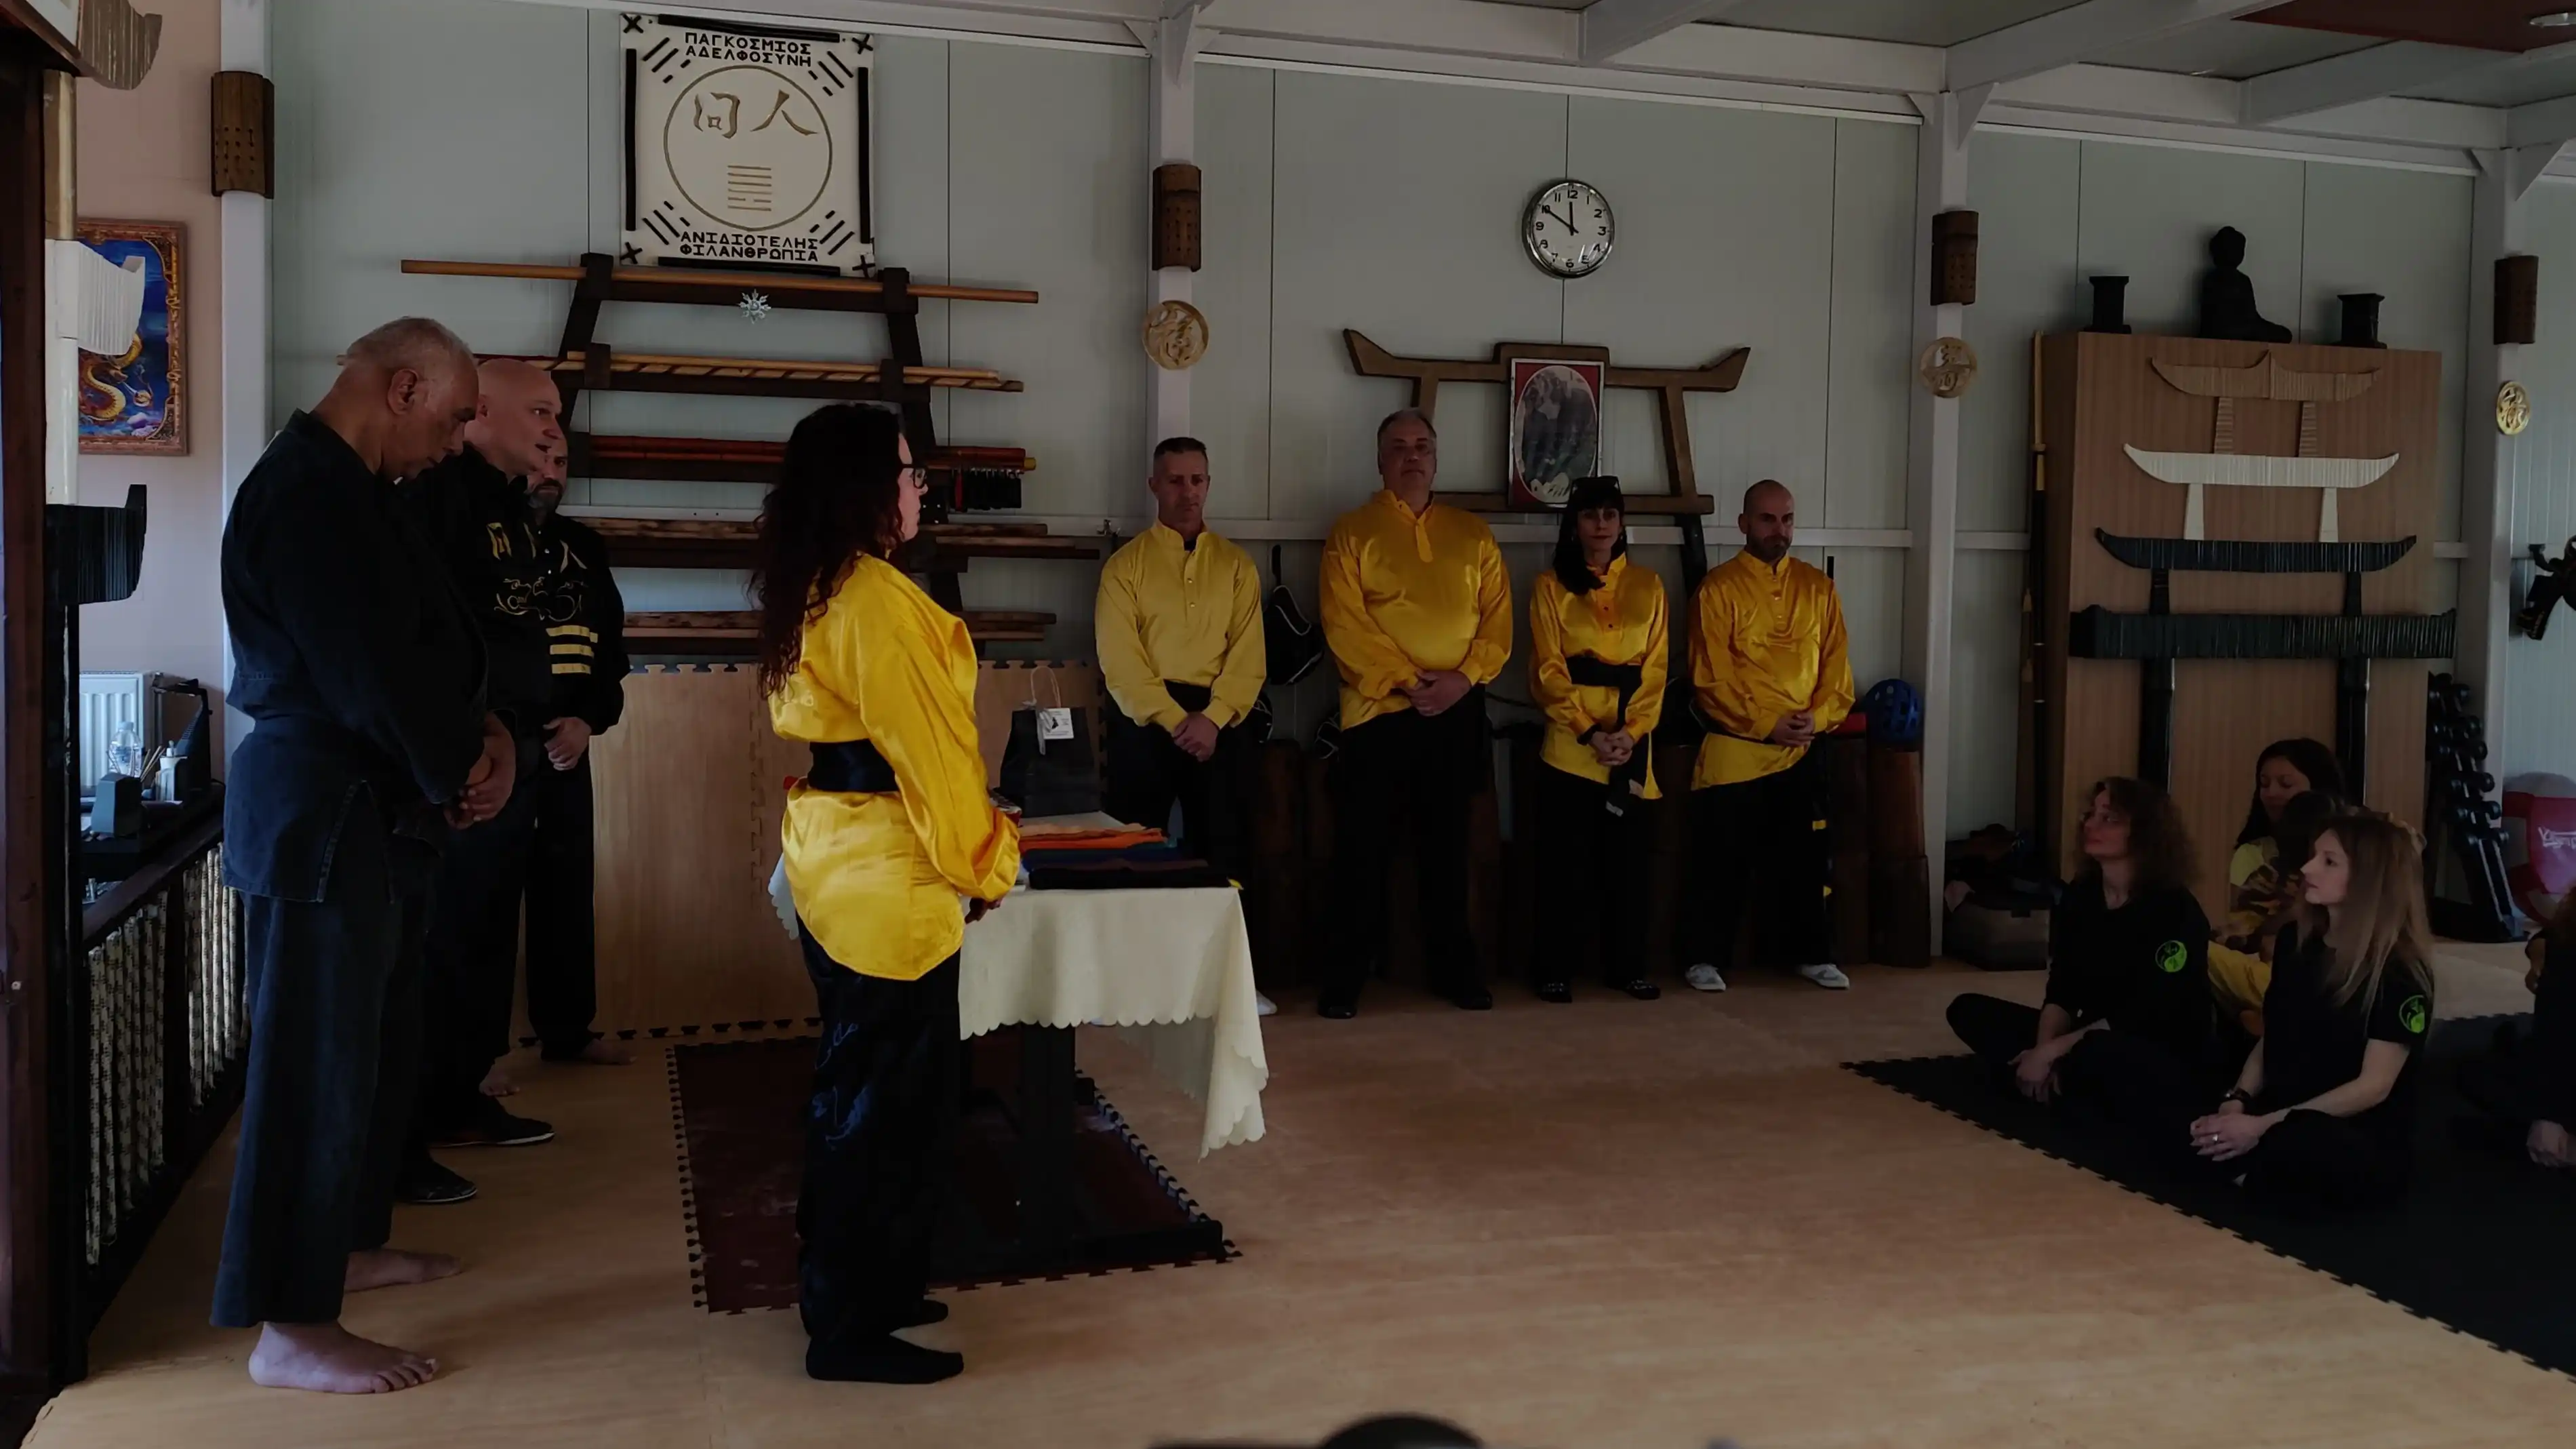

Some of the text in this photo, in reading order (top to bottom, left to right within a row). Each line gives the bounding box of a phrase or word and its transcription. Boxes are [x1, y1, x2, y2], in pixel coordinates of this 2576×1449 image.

[685, 32, 811, 54] ΠΑΓΚΟΣΜΙΟΣ
[686, 45, 811, 66] ΑΔΕΛΦΟΣΥΝΗ
[1554, 193, 1561, 202] 11
[1567, 190, 1578, 199] 12
[1542, 205, 1550, 214] 10
[1594, 209, 1602, 218] 2
[1535, 222, 1544, 231] 9
[1598, 226, 1606, 235] 3
[681, 231, 818, 250] ΑΝΙΔΙΟΤΕΛΗΣ
[1539, 239, 1548, 248] 8
[680, 244, 818, 262] ΦΙΛΑΝΘΡΩΠΙΑ
[1565, 259, 1574, 268] 6
